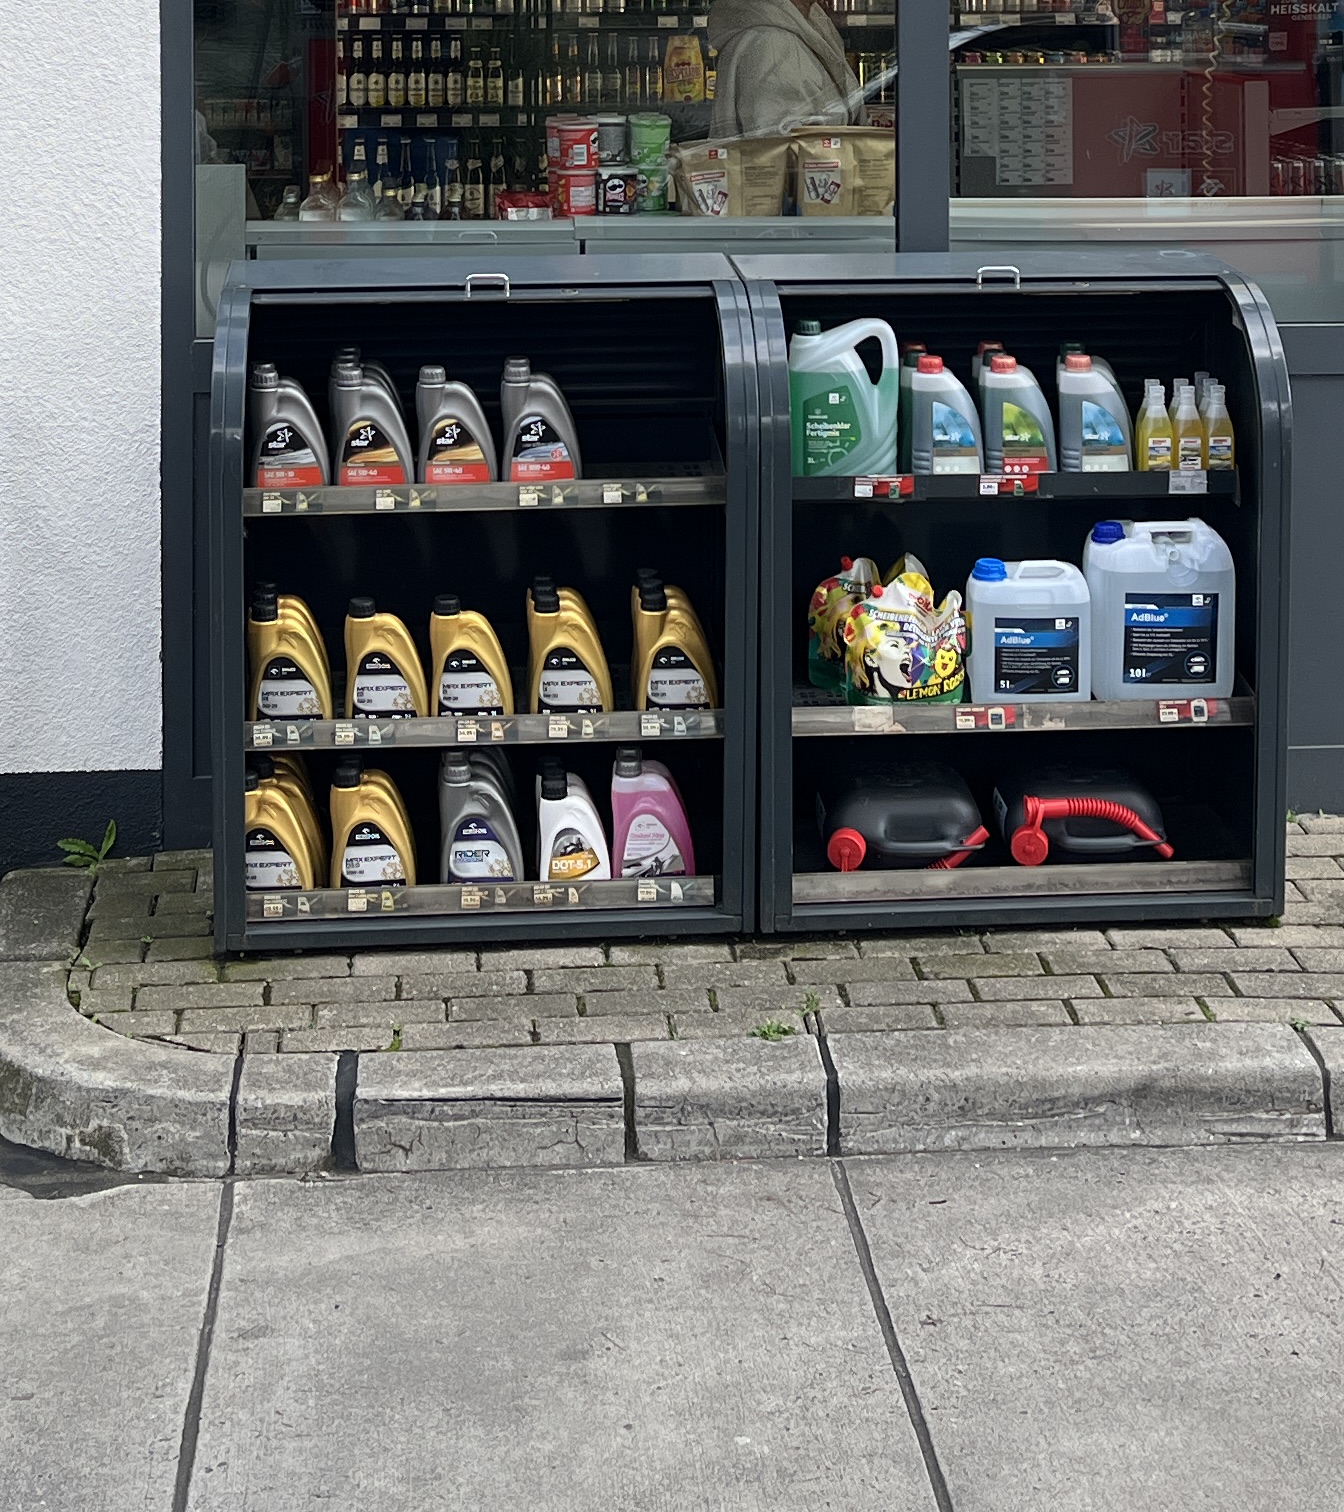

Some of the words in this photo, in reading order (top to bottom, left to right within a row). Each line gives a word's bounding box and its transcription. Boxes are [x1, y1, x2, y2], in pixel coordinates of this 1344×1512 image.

[1270, 2, 1340, 15] HEISSKALT
[906, 684, 941, 700] LEMON
[364, 854, 397, 862] EXPERT
[455, 849, 491, 858] RIDER
